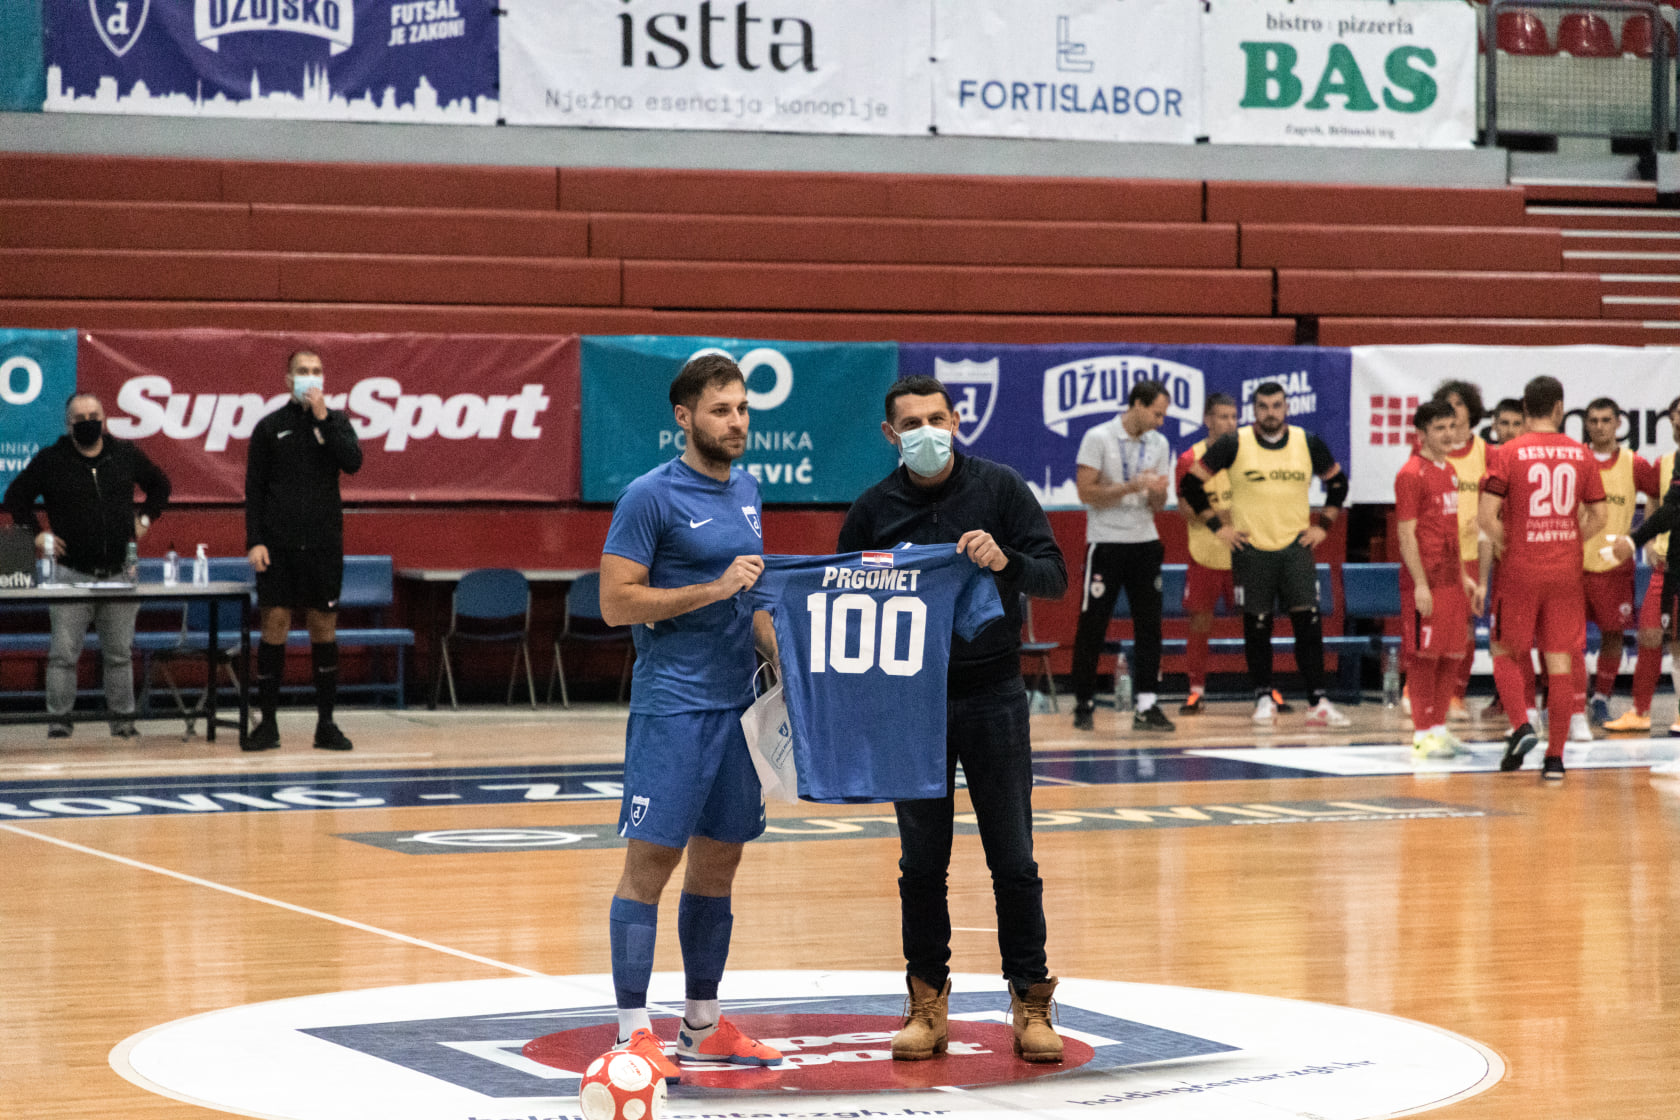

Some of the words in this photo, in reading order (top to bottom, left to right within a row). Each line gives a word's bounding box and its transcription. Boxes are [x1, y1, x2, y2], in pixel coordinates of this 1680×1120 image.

[391, 0, 460, 26] FUTSAL
[1266, 13, 1323, 31] bistro
[1338, 15, 1414, 38] pizzeria
[388, 26, 406, 46] JE
[409, 18, 465, 43] ZAKON!
[617, 0, 819, 73] istta
[1239, 40, 1437, 113] BAS
[645, 94, 763, 118] esencija
[775, 95, 889, 120] konoplje
[107, 375, 549, 451] SupSport
[1518, 446, 1584, 461] SESVETE
[1528, 462, 1576, 517] 20
[822, 566, 921, 592] PRGOMET
[807, 592, 927, 677] 100
[1422, 626, 1433, 649] 7
